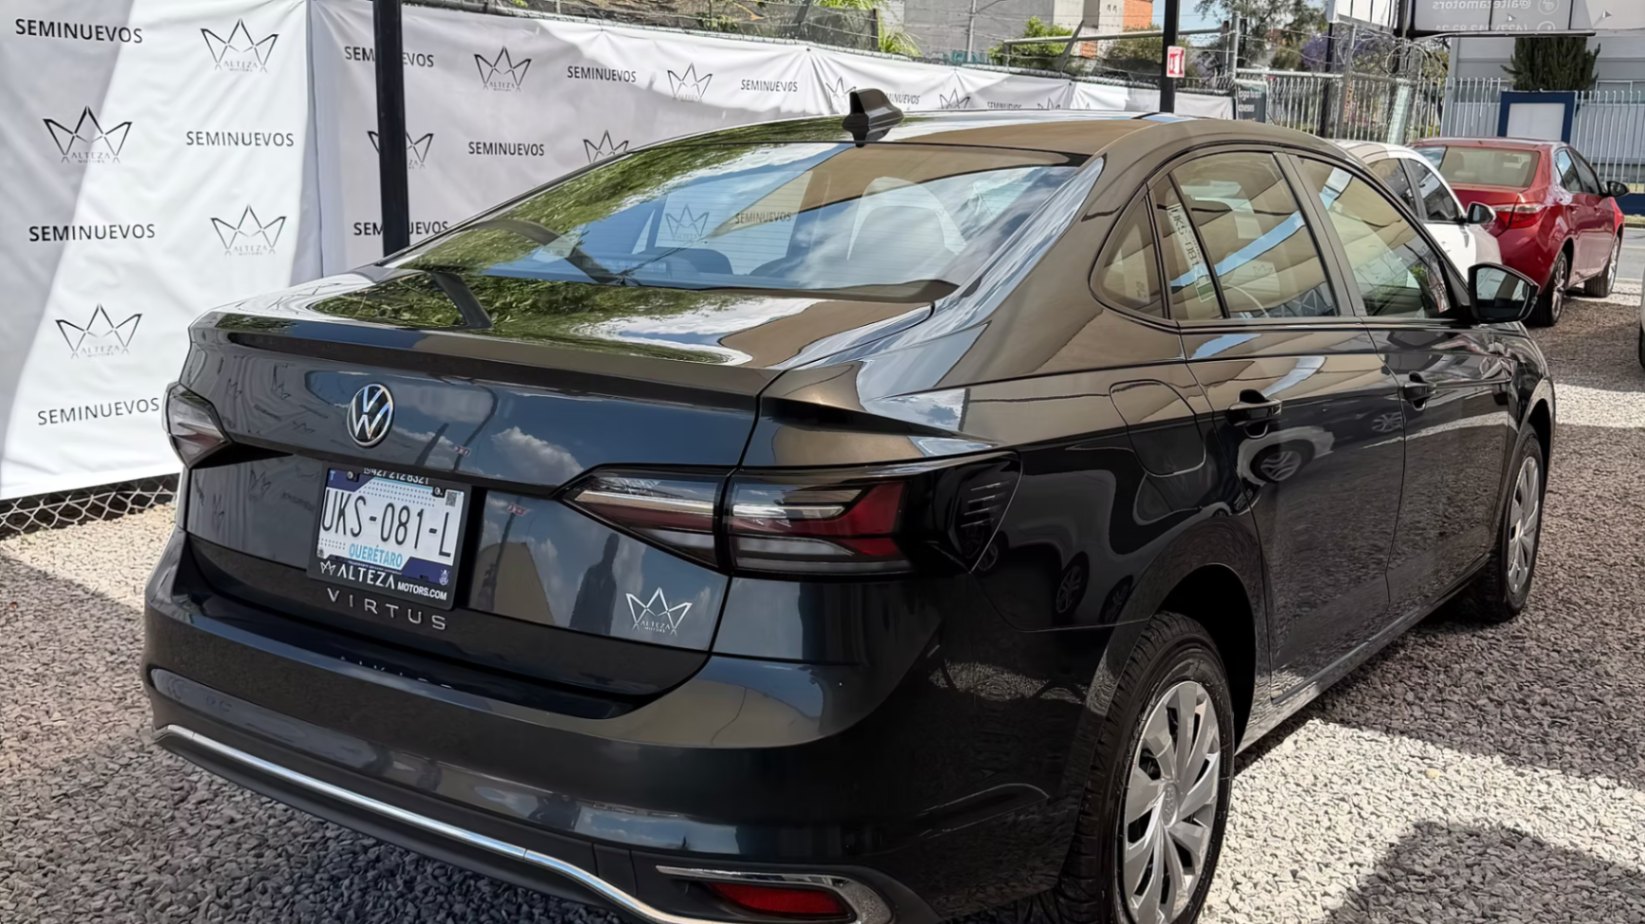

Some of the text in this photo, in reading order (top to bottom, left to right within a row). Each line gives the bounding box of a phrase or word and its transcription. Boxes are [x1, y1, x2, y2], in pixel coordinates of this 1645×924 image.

[15, 18, 143, 44] SEMINUEVOS
[343, 45, 435, 68] SEMEVOS
[567, 65, 637, 83] SEMINUEVOS
[740, 79, 798, 92] SEMINUEVOS
[185, 130, 295, 148] SEMINUEVOS
[71, 151, 111, 160] ALTEZA
[468, 141, 545, 157] SEMINUEVOS
[734, 211, 792, 226] SEMINUEVOS
[29, 223, 156, 242] SEMINUEVOS
[37, 397, 161, 426] SEMINUEVOS
[321, 488, 452, 558] UKS-081-L
[348, 543, 403, 569] QUERÉTARO
[337, 563, 395, 590] ALTEZA
[397, 580, 447, 601] MOTORS.COM
[327, 587, 446, 630] VIRTUS
[641, 620, 670, 631] ALTEZA
